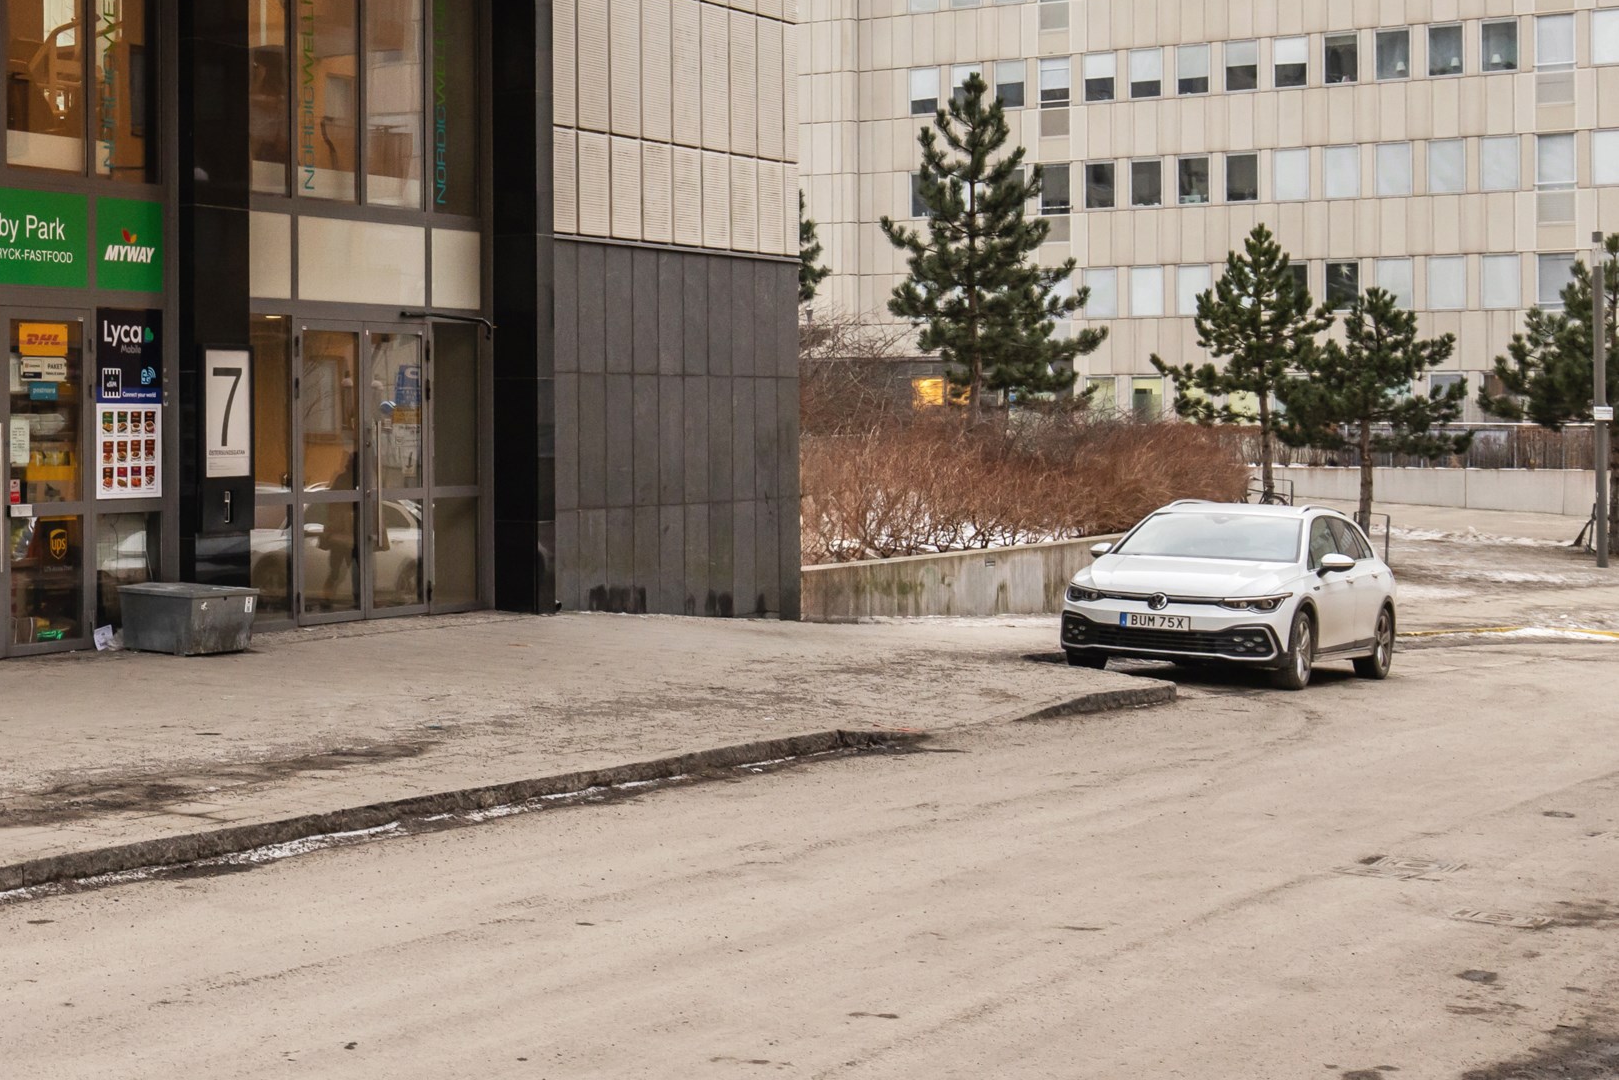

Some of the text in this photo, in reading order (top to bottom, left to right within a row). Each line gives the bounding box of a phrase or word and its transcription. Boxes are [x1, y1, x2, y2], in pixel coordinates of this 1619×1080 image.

[26, 214, 66, 241] Park
[104, 244, 156, 264] MYWAY
[26, 333, 61, 346] DHL
[103, 320, 142, 347] Lyca
[121, 344, 142, 354] Mobile
[212, 367, 242, 447] 7
[1131, 614, 1185, 629] BUM 75X
